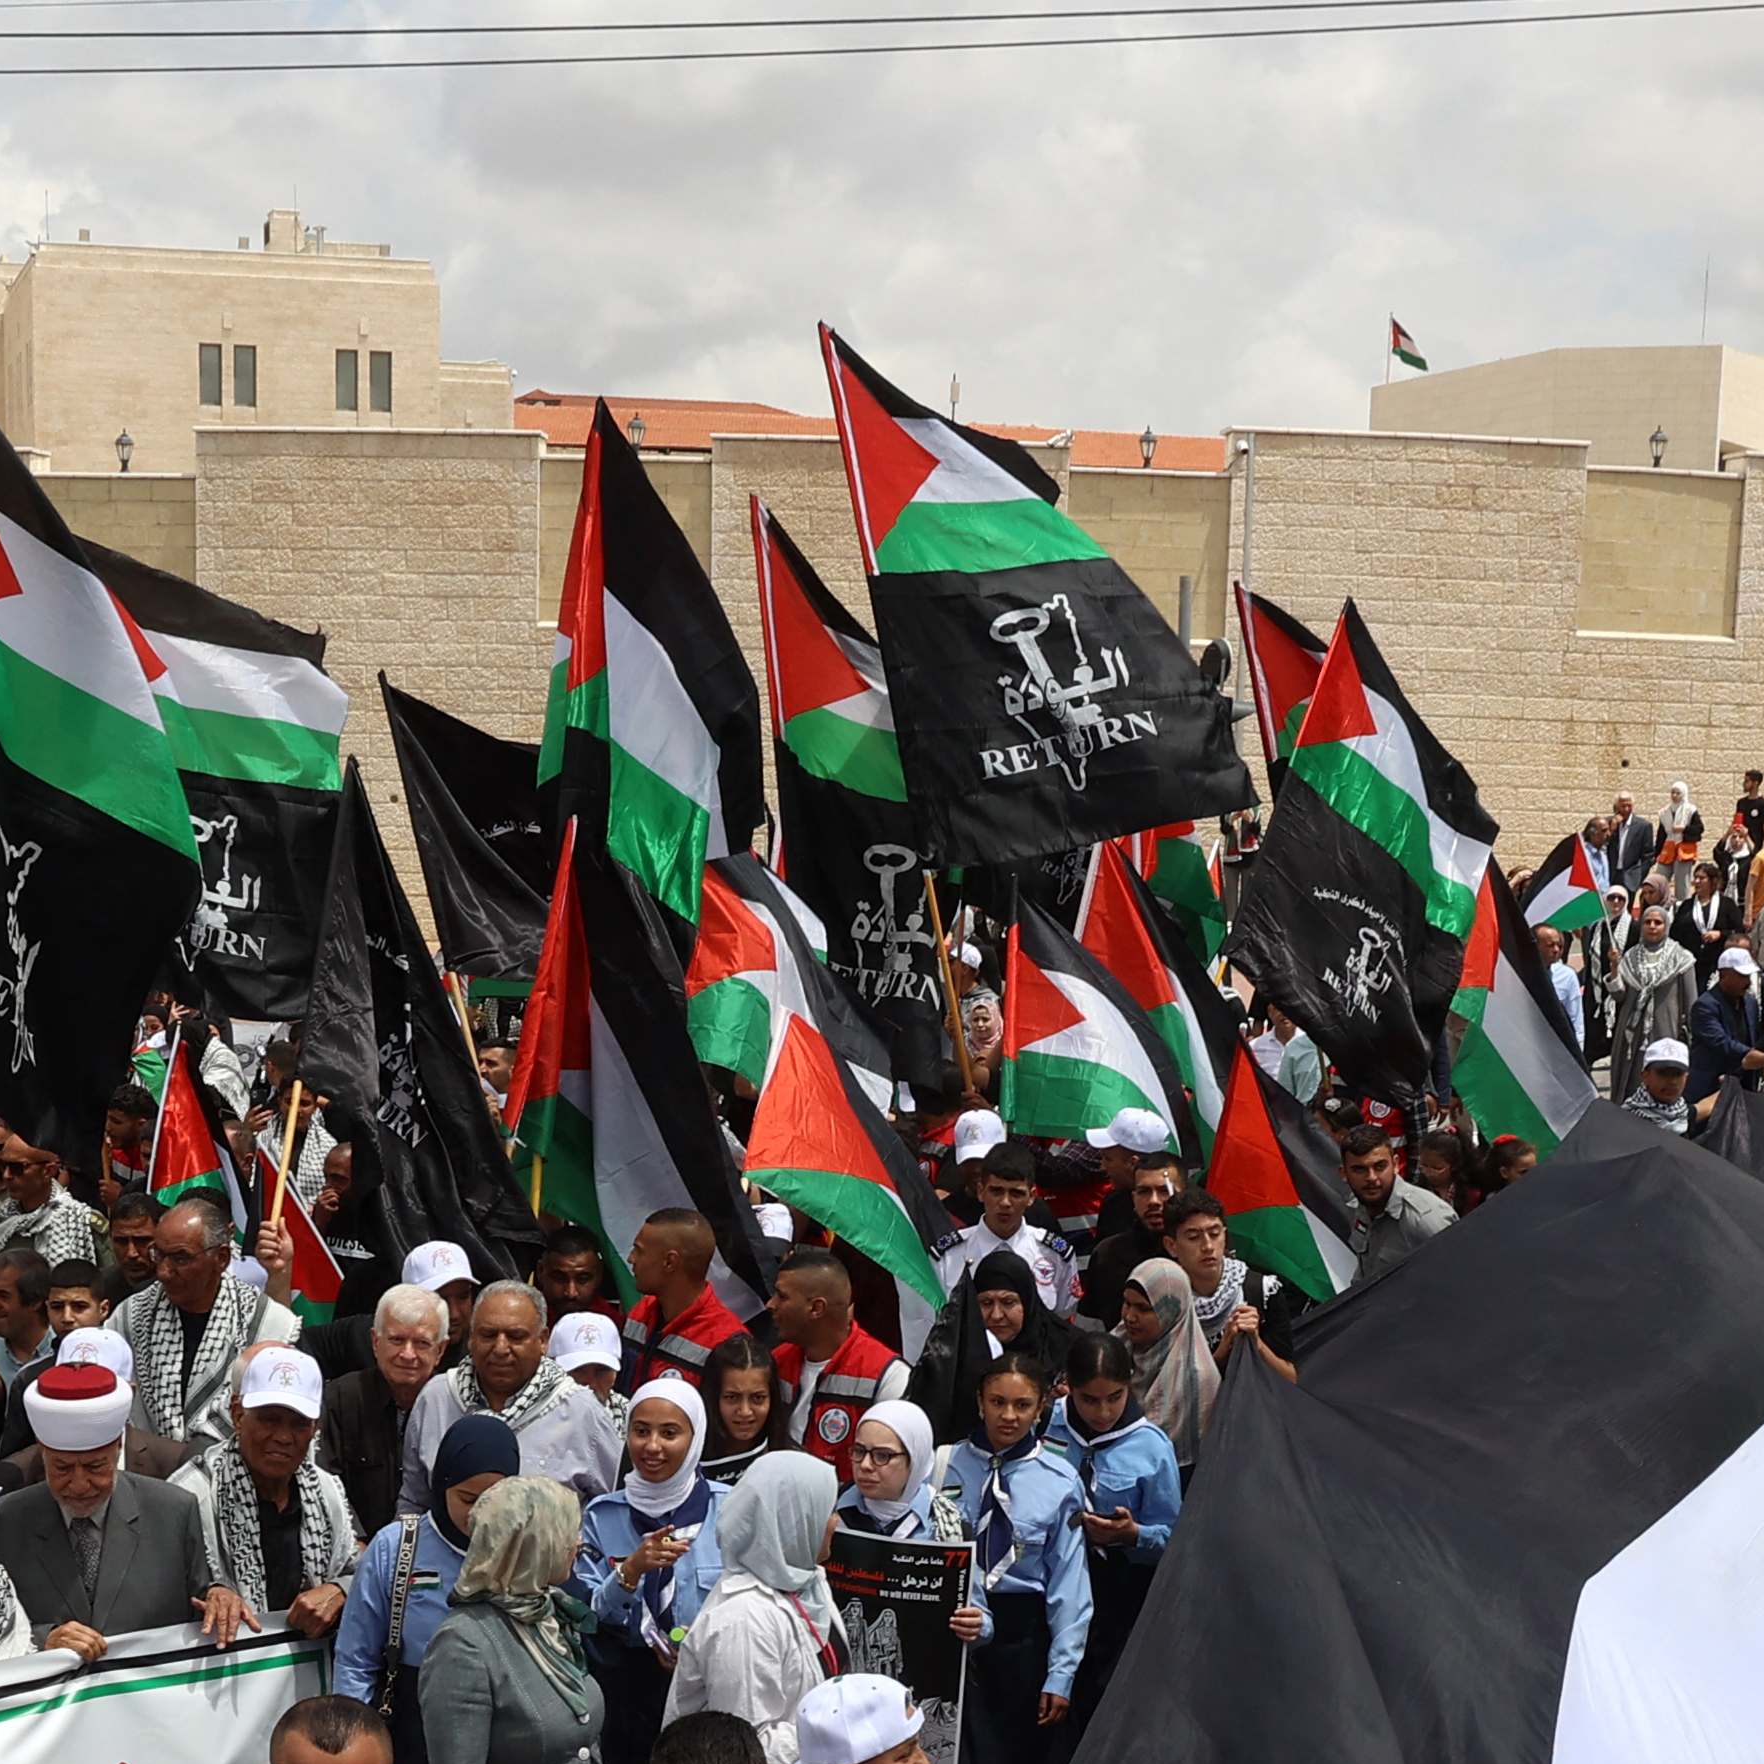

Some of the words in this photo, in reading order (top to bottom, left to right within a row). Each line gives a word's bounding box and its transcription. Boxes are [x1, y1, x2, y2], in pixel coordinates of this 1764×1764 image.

[997, 646, 1129, 717] العودة
[979, 710, 1158, 780] RETURN
[190, 922, 267, 961] URN
[1322, 967, 1381, 1024] RETURN
[943, 1551, 969, 1568] 77
[390, 1577, 407, 1647] CHRISTIAN
[399, 1542, 414, 1577] DIOR
[889, 1590, 901, 1599] will
[902, 1591, 921, 1600] NEVER
[901, 1574, 929, 1589] نرحل
[930, 1576, 943, 1589] لن
[957, 1569, 967, 1592] Years
